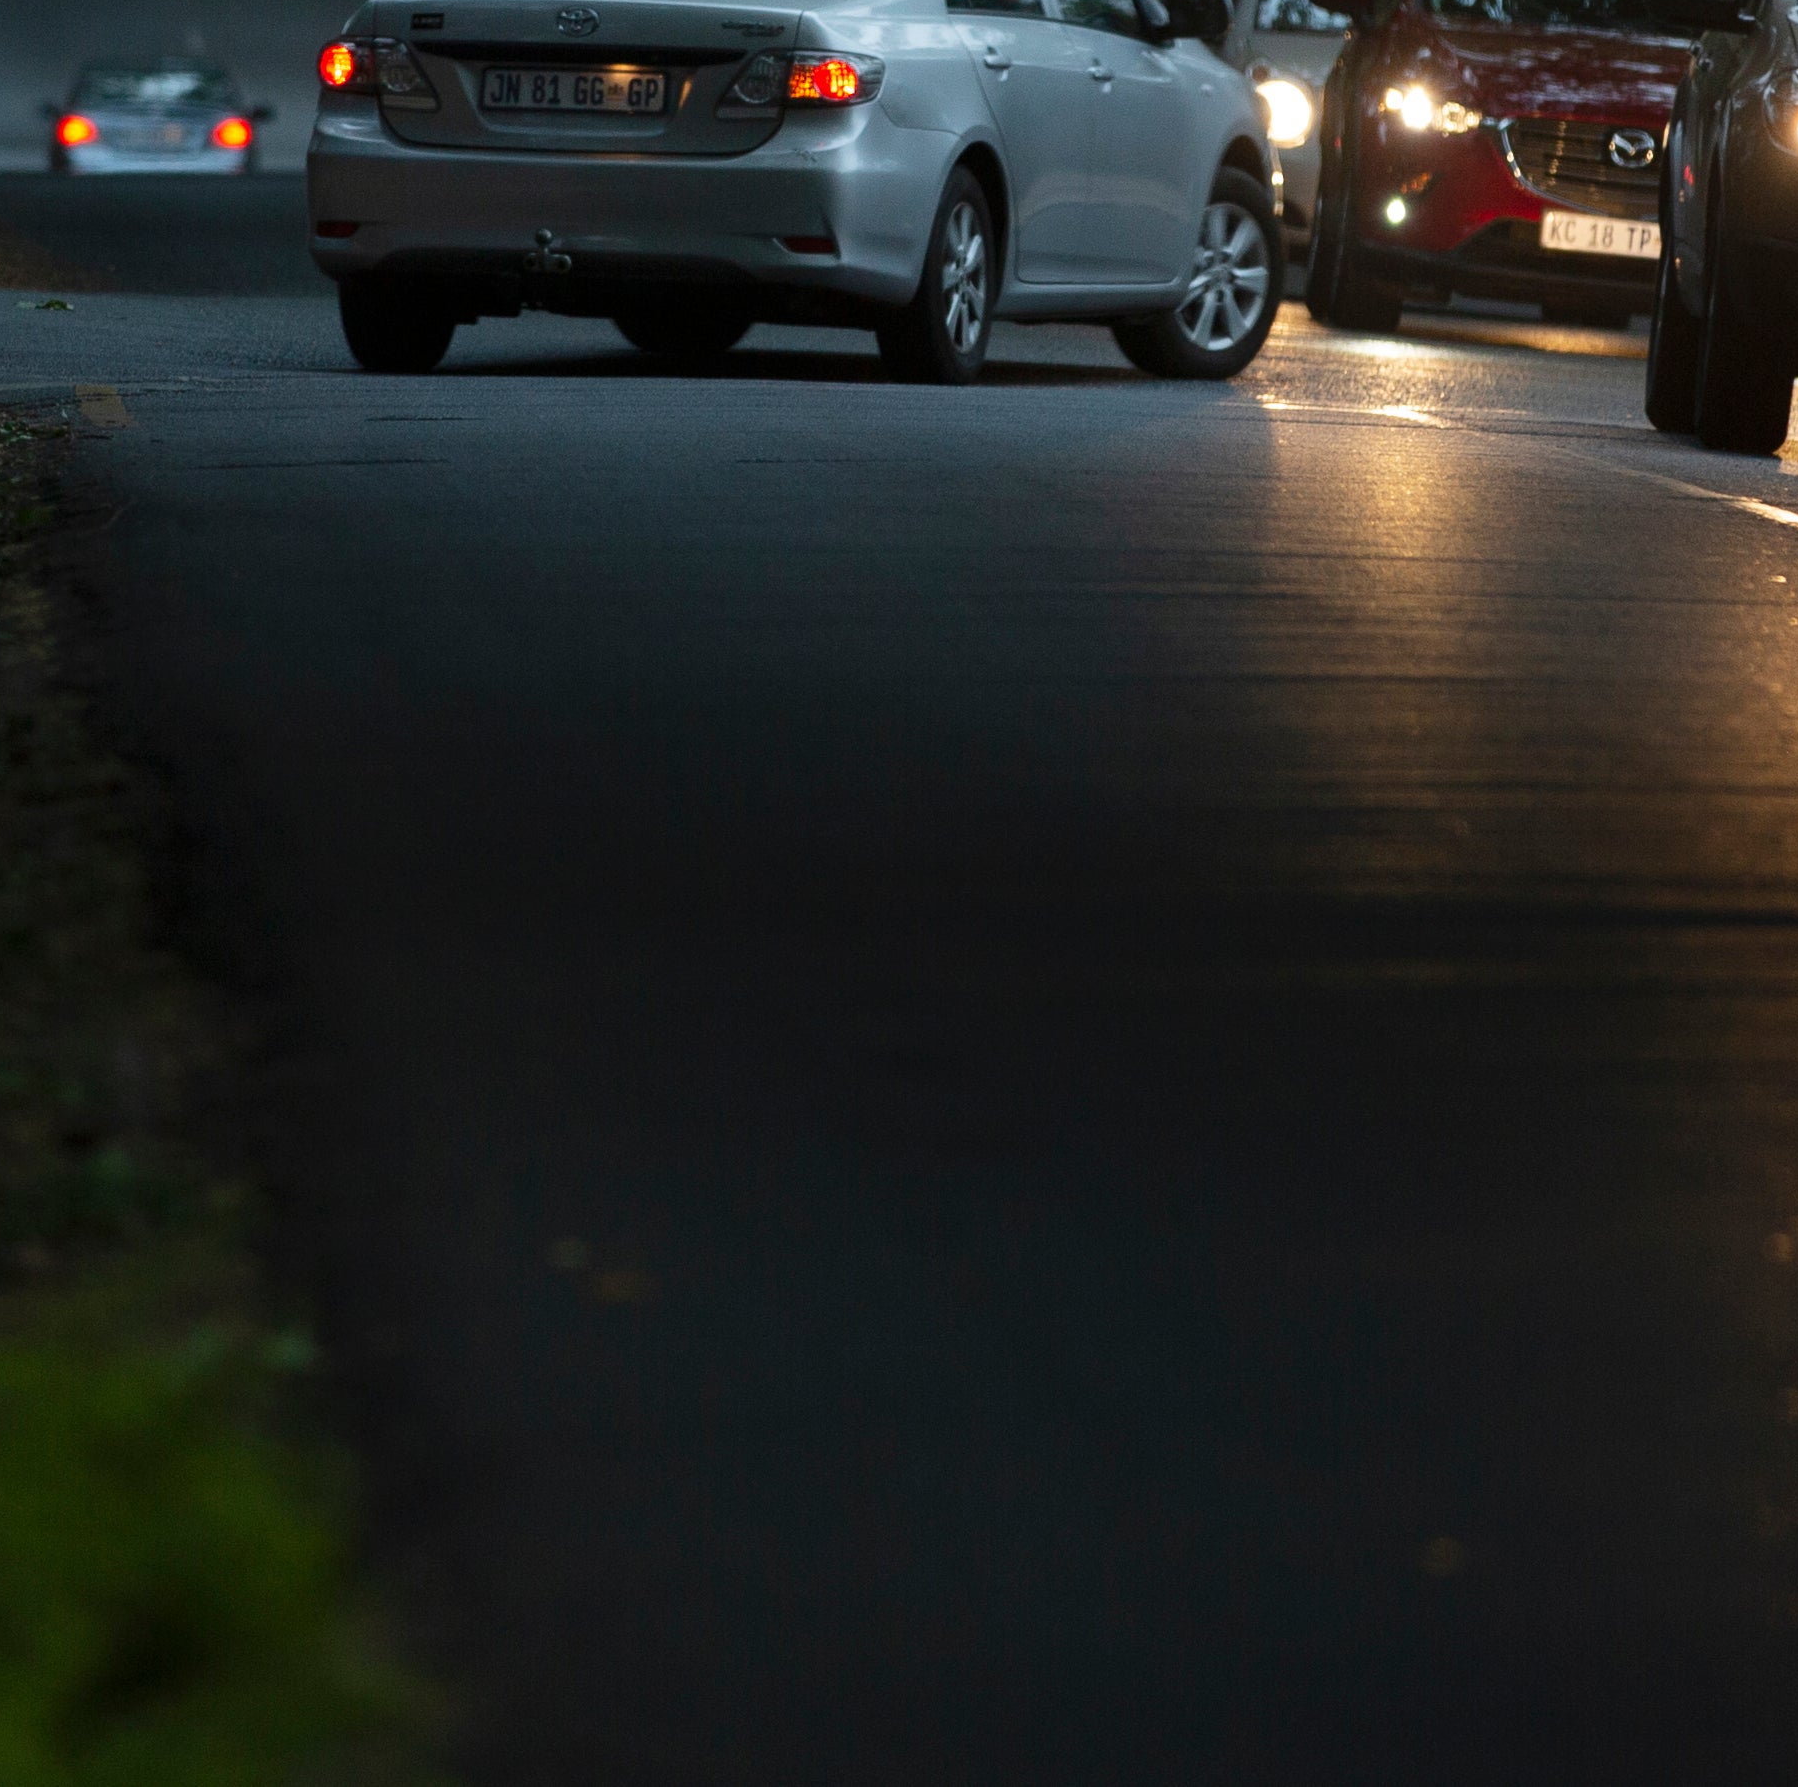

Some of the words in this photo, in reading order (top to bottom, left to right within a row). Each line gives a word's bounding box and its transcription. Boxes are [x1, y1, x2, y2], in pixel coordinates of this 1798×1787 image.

[490, 73, 521, 104] JN
[532, 74, 560, 105] 81
[574, 75, 604, 106] GG
[627, 77, 659, 108] GP
[1550, 218, 1576, 244] KC
[1589, 222, 1614, 248] 18
[1627, 226, 1652, 252] TP
